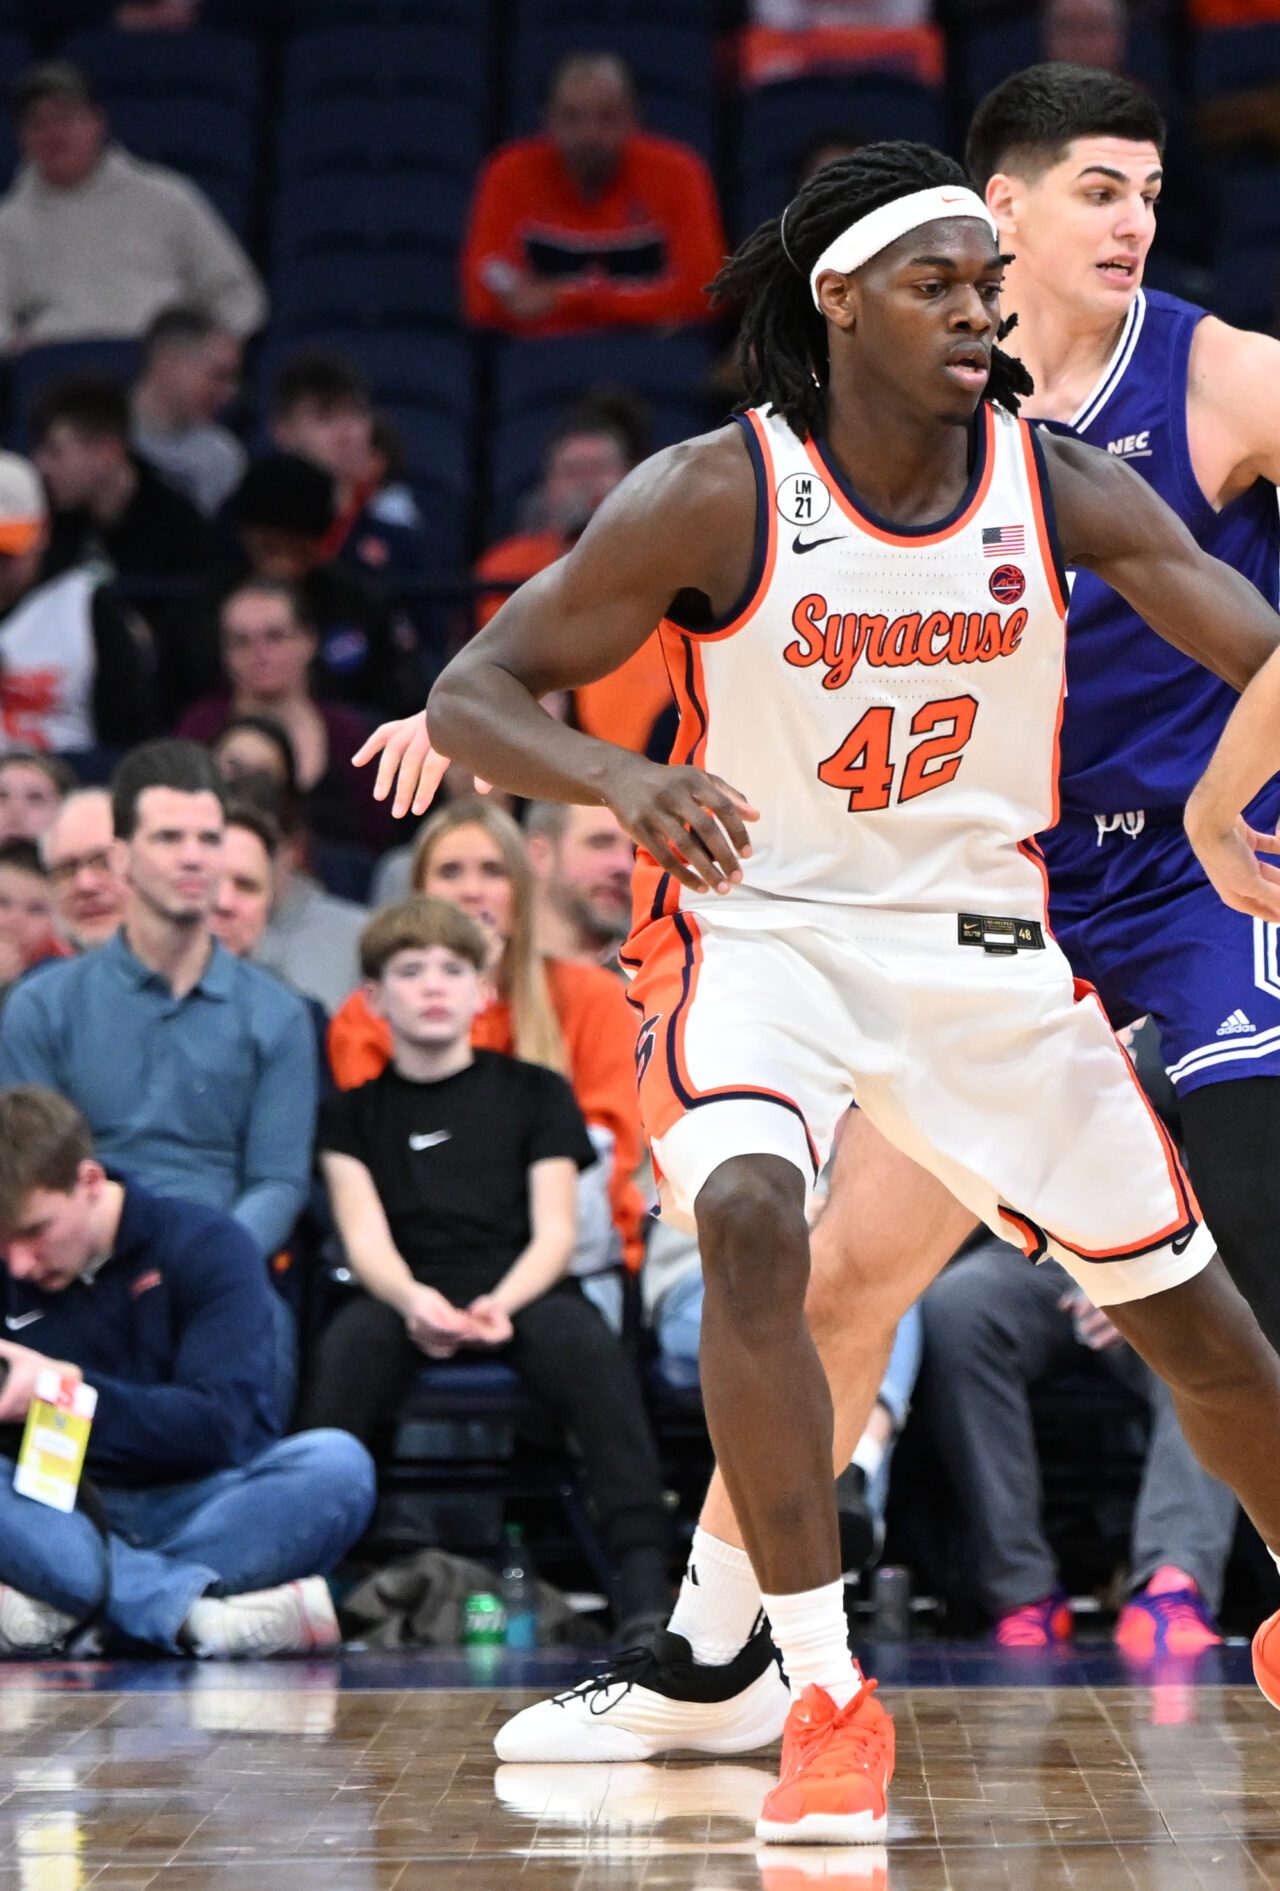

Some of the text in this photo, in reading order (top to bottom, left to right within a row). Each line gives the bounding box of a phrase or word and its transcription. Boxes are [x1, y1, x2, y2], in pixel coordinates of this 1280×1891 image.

[1107, 430, 1150, 455] NEC
[795, 479, 812, 495] LM
[795, 496, 812, 519] 21
[783, 593, 1028, 690] Syracuse
[817, 694, 979, 813] 42
[1018, 928, 1032, 941] 48
[1216, 1023, 1257, 1036] adidas
